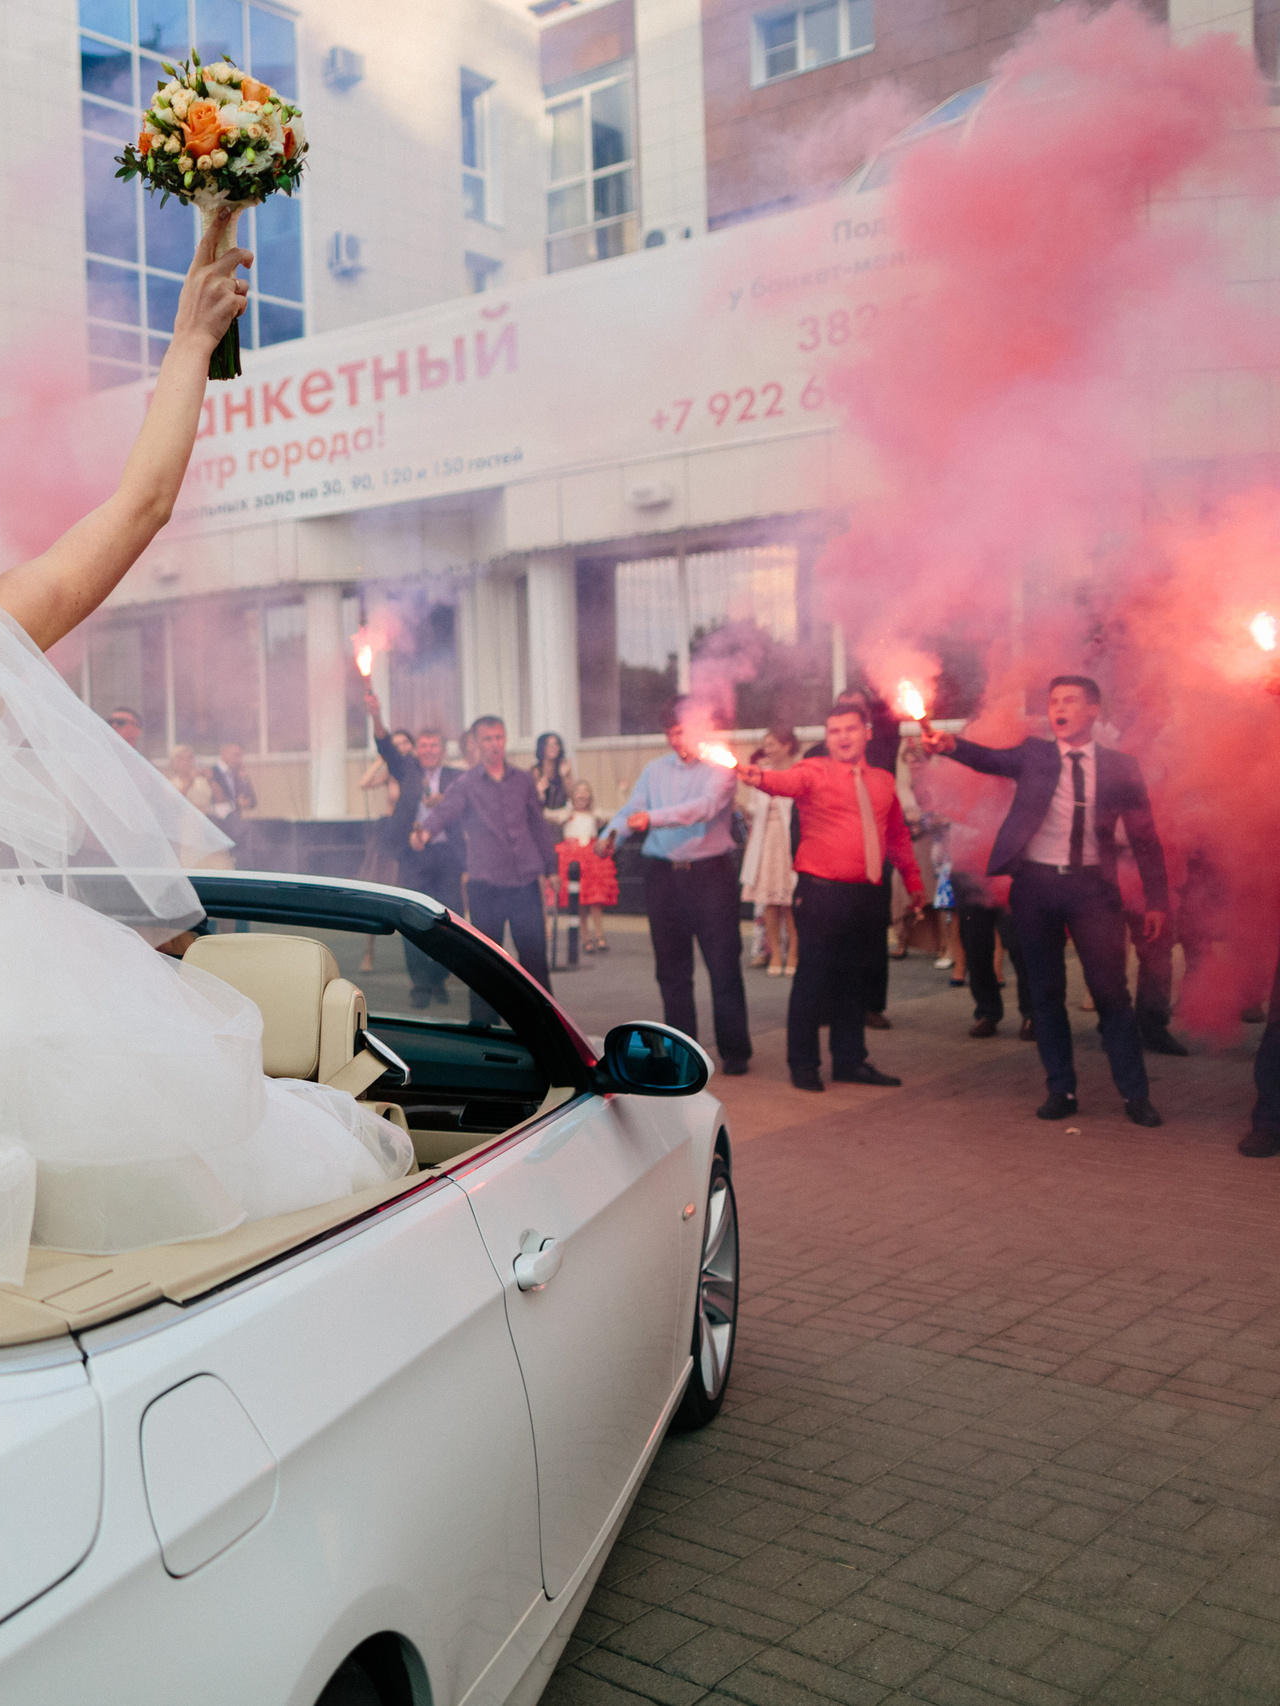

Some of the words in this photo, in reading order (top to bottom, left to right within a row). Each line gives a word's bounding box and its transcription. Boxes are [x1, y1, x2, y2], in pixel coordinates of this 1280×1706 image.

[146, 303, 519, 441] анкетный
[650, 399, 696, 434] +7
[707, 380, 786, 427] 922
[183, 452, 238, 491] нтр
[246, 412, 386, 478] города!
[382, 465, 414, 487] 120
[434, 456, 465, 477] 150
[468, 445, 524, 472] гостей
